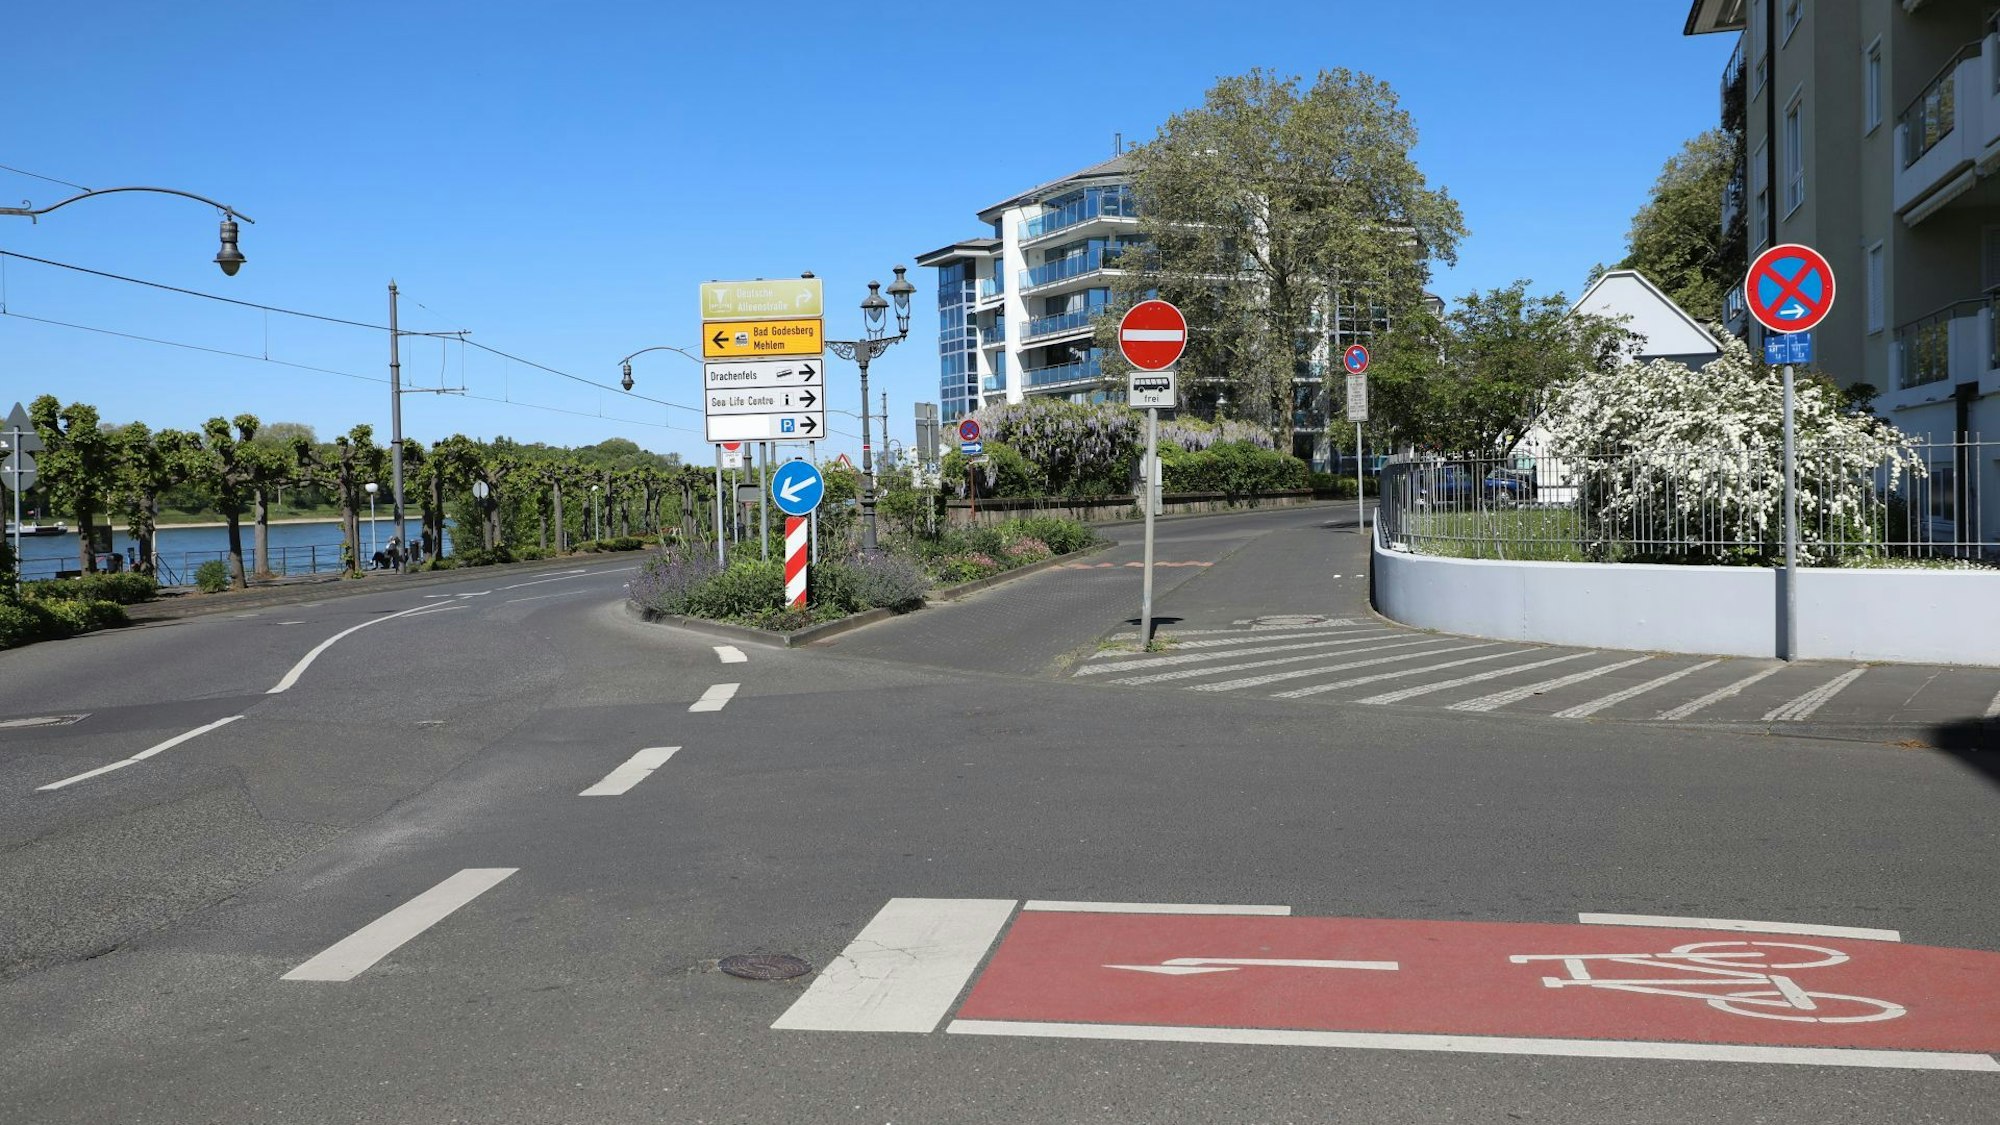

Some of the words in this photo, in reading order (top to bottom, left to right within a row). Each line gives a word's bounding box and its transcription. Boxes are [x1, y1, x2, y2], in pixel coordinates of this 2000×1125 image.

[753, 327, 768, 337] Bad
[771, 325, 814, 337] Godesberg
[753, 341, 785, 350] Mehlem
[710, 371, 757, 381] Drachenfels
[711, 397, 726, 407] Sea
[729, 396, 745, 406] Life
[748, 396, 774, 406] Centre
